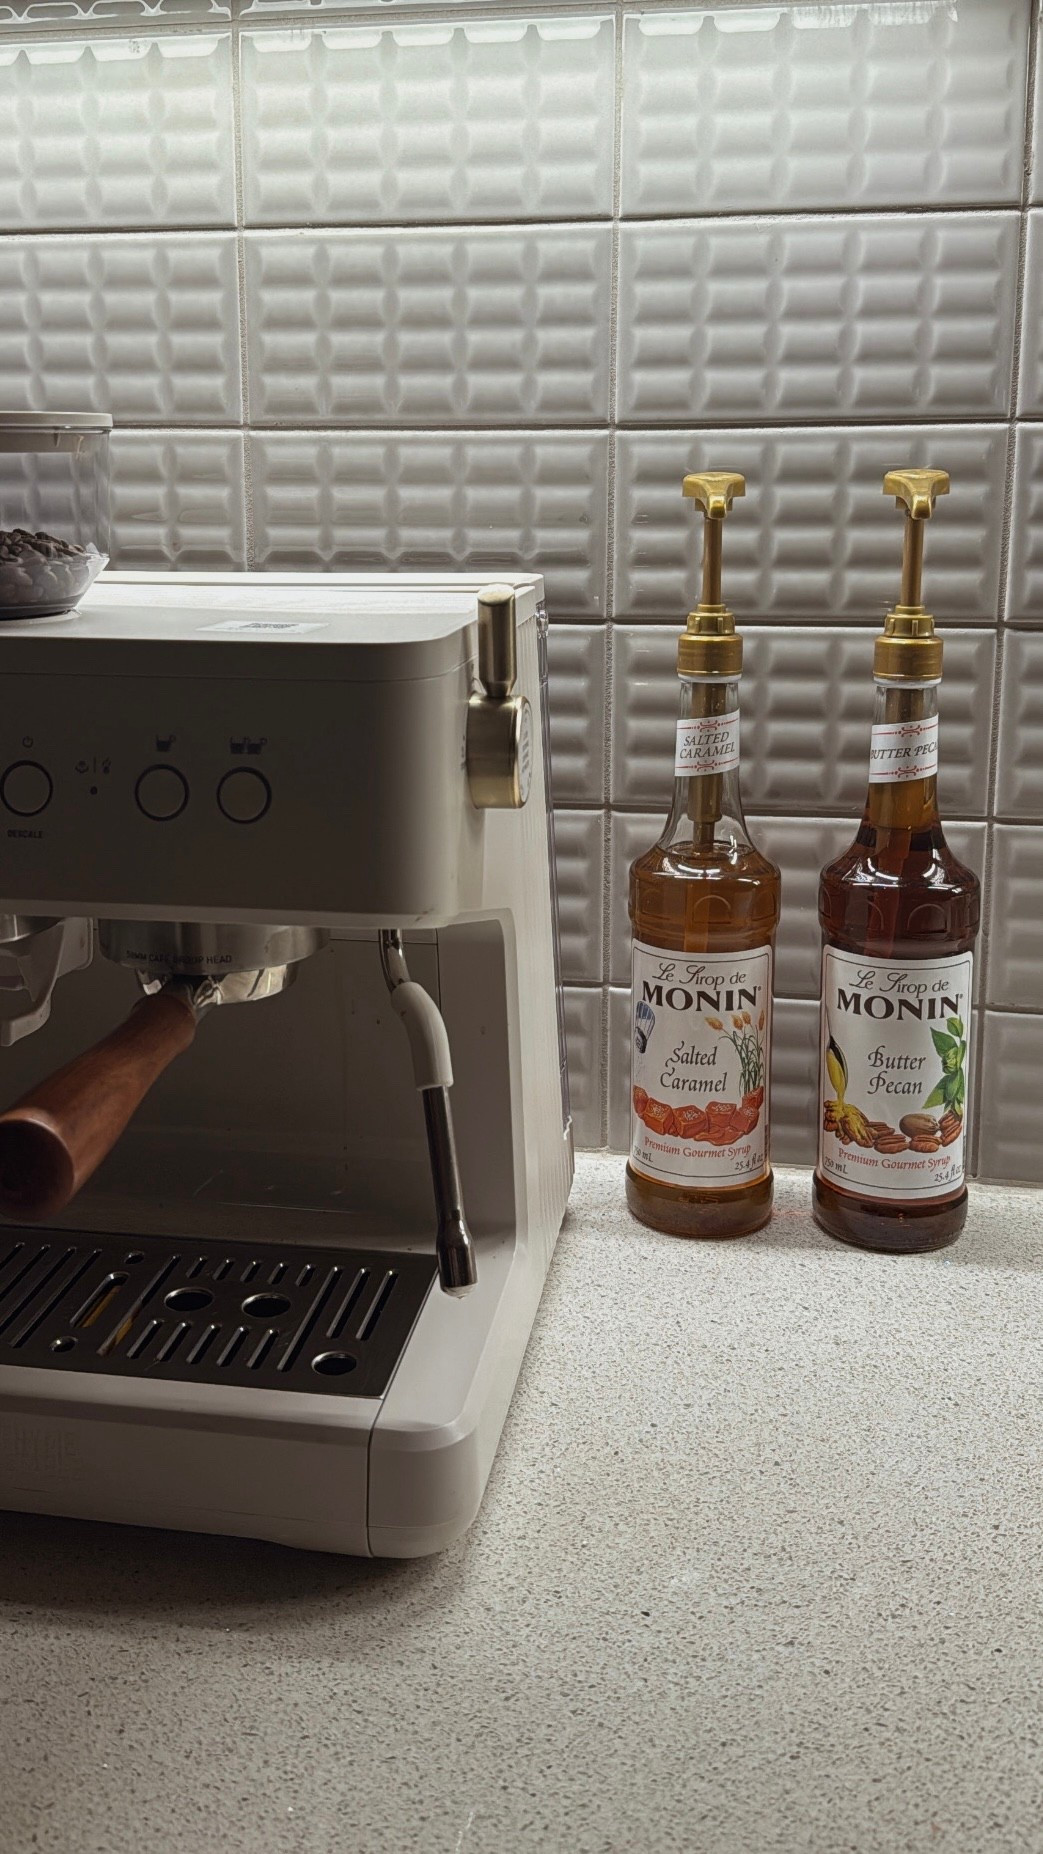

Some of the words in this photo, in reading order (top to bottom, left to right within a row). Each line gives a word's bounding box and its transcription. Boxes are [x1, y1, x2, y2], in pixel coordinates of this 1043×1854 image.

[679, 742, 735, 759] CARAMEL
[684, 731, 729, 746] SALTED
[206, 955, 232, 964] HEAD
[652, 962, 674, 983] Le
[679, 965, 725, 990] Sirop
[730, 971, 747, 985] de
[849, 970, 873, 990] Le
[879, 972, 927, 998] Sirop
[932, 979, 949, 992] de
[642, 980, 757, 1012] MONIN
[837, 988, 959, 1020] MONIN
[665, 1041, 717, 1068] Salted
[867, 1045, 926, 1071] Butter
[660, 1067, 728, 1093] Caramel
[867, 1071, 923, 1095] Pecan
[644, 1136, 681, 1155] Premium
[683, 1146, 726, 1158] Gourmet
[728, 1144, 752, 1161] Syrup
[838, 1147, 878, 1167] Premium
[881, 1158, 925, 1170] Gourmet
[928, 1155, 951, 1173] Syrup
[734, 1159, 750, 1171] 25.4
[835, 1162, 849, 1175] mL
[934, 1171, 949, 1183] 25.4
